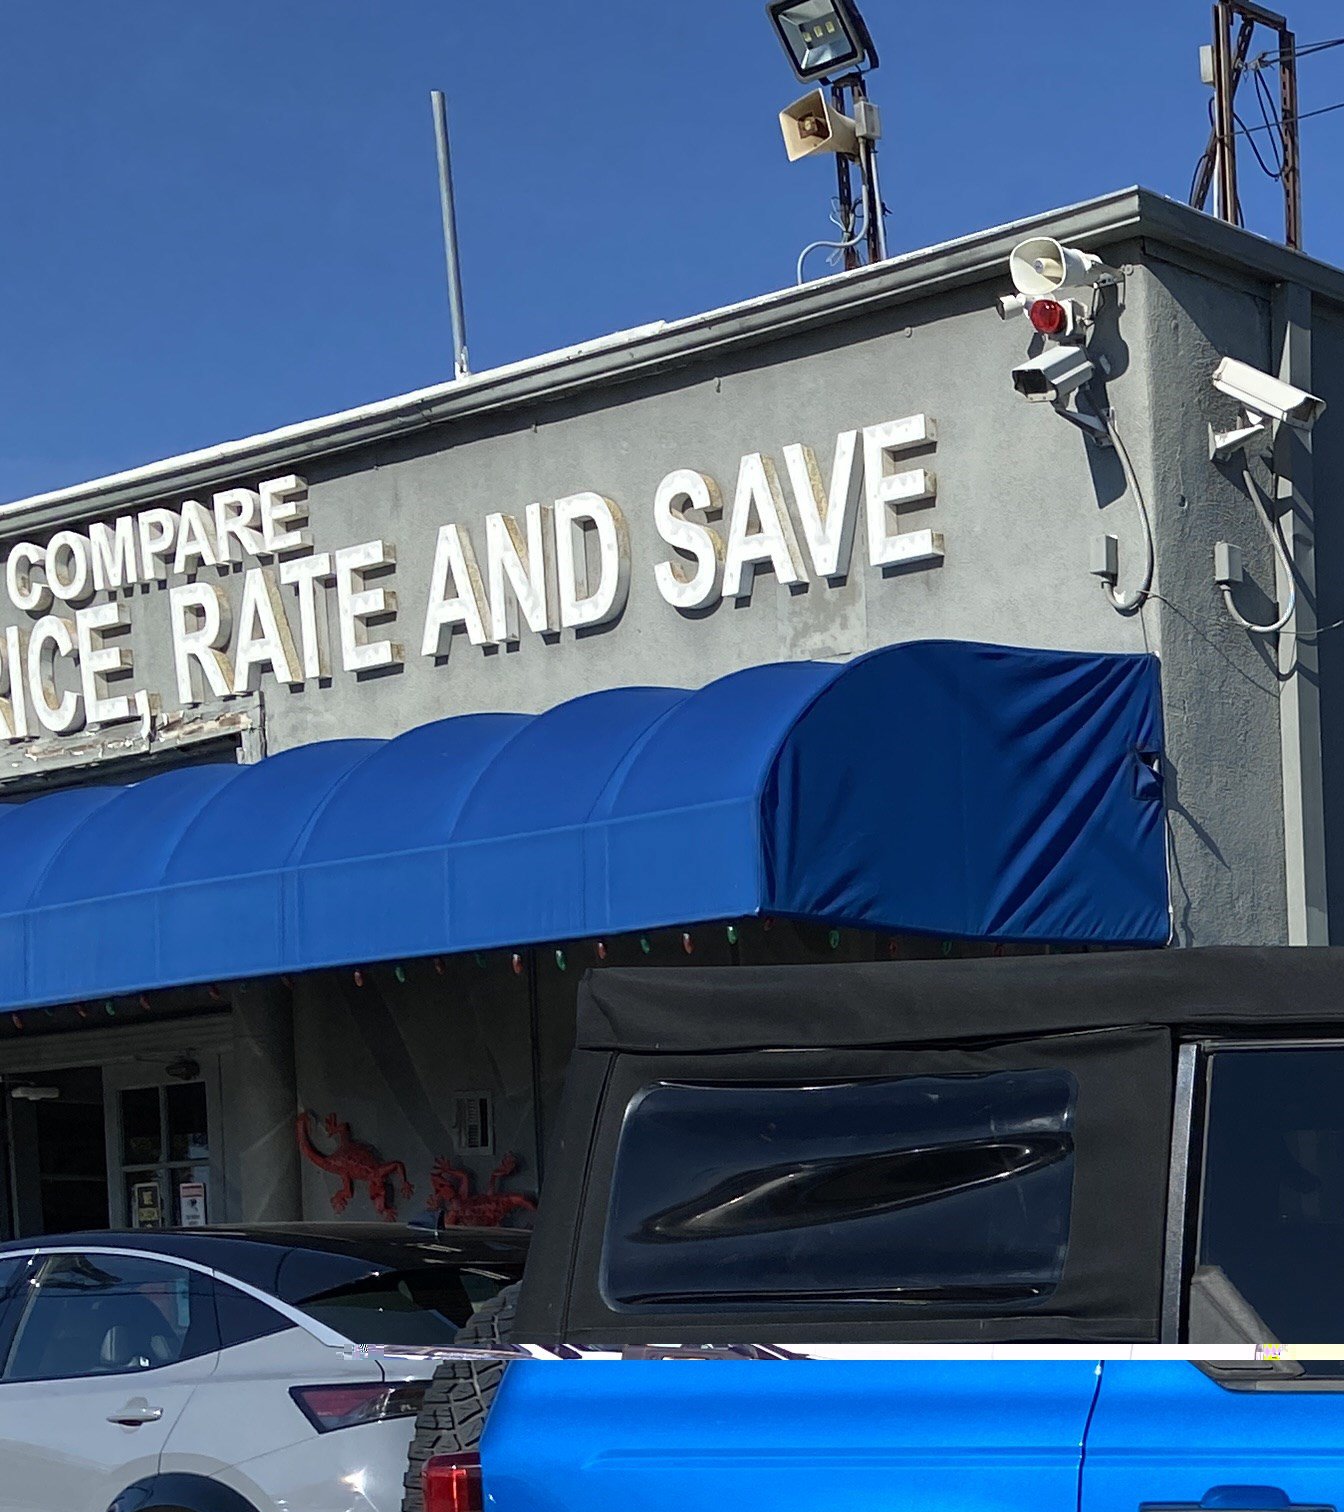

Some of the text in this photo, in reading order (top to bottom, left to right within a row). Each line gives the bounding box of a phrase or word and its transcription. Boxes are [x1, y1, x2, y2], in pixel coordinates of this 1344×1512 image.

[0, 414, 942, 740] ICE, RATE AND SAVE
[7, 474, 308, 610] COMPARE
